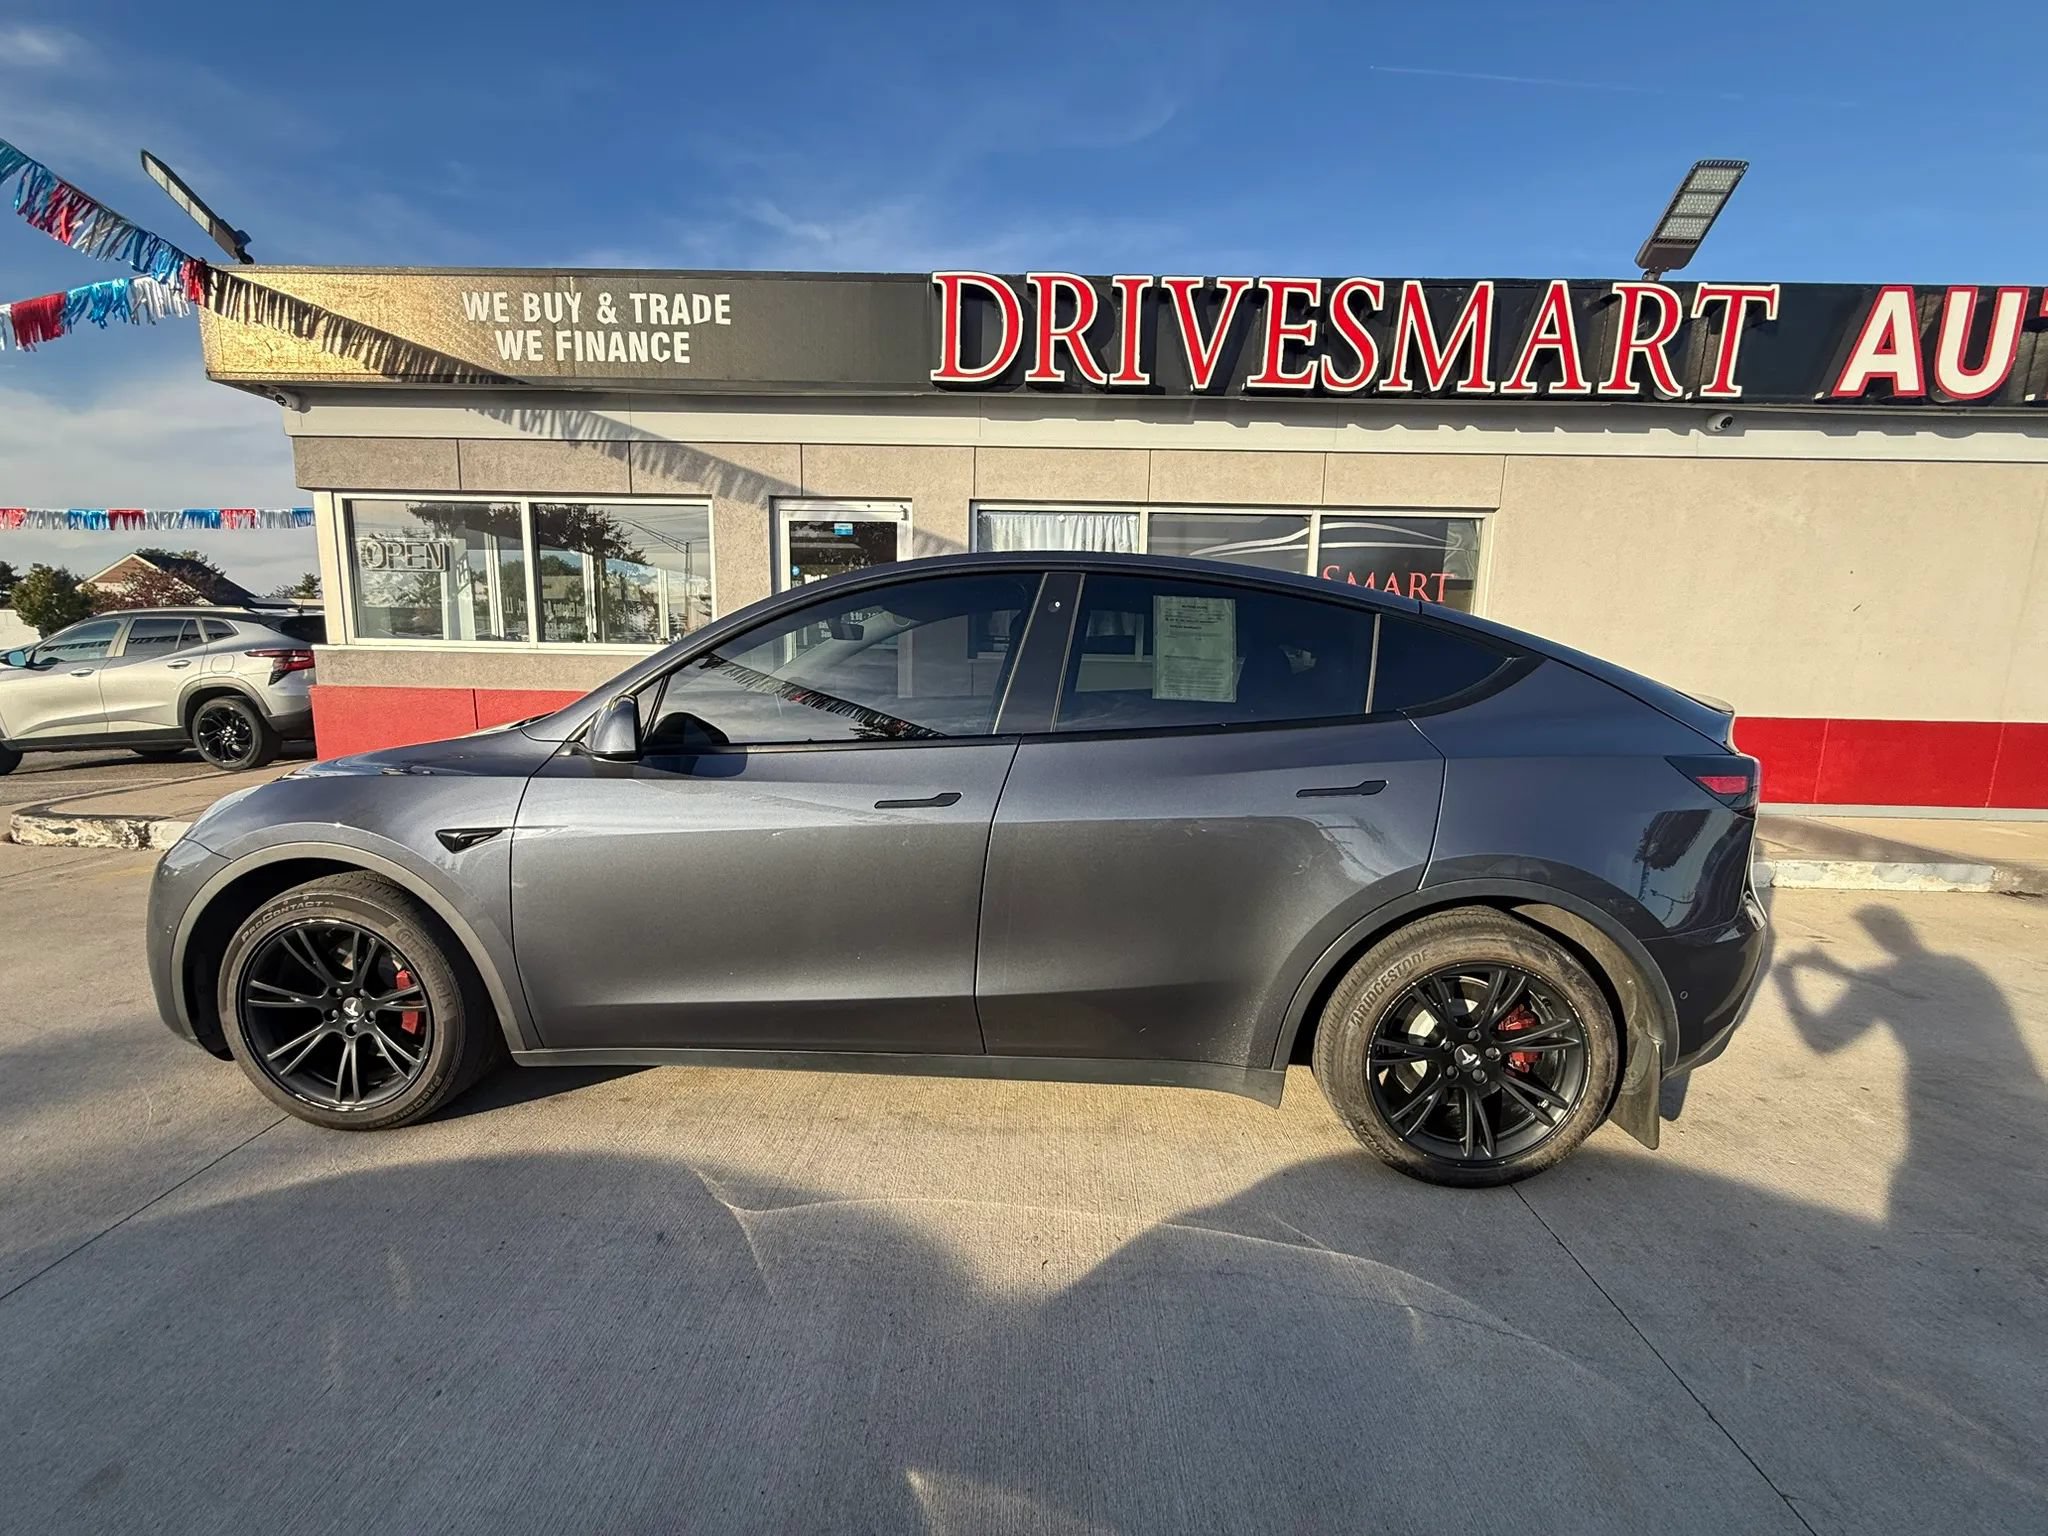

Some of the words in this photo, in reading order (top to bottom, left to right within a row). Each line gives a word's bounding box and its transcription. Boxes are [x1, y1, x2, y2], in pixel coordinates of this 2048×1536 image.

[462, 291, 510, 323] WE
[523, 291, 582, 324] BUY
[596, 292, 619, 324] &
[629, 292, 731, 325] TRADE
[495, 329, 544, 361] WE
[556, 329, 690, 363] FINANCE
[930, 271, 1780, 398] DRIVESMART
[1831, 284, 2048, 400] AU
[365, 541, 445, 570] OPEN
[1351, 949, 1430, 1029] BRIDGESTONE
